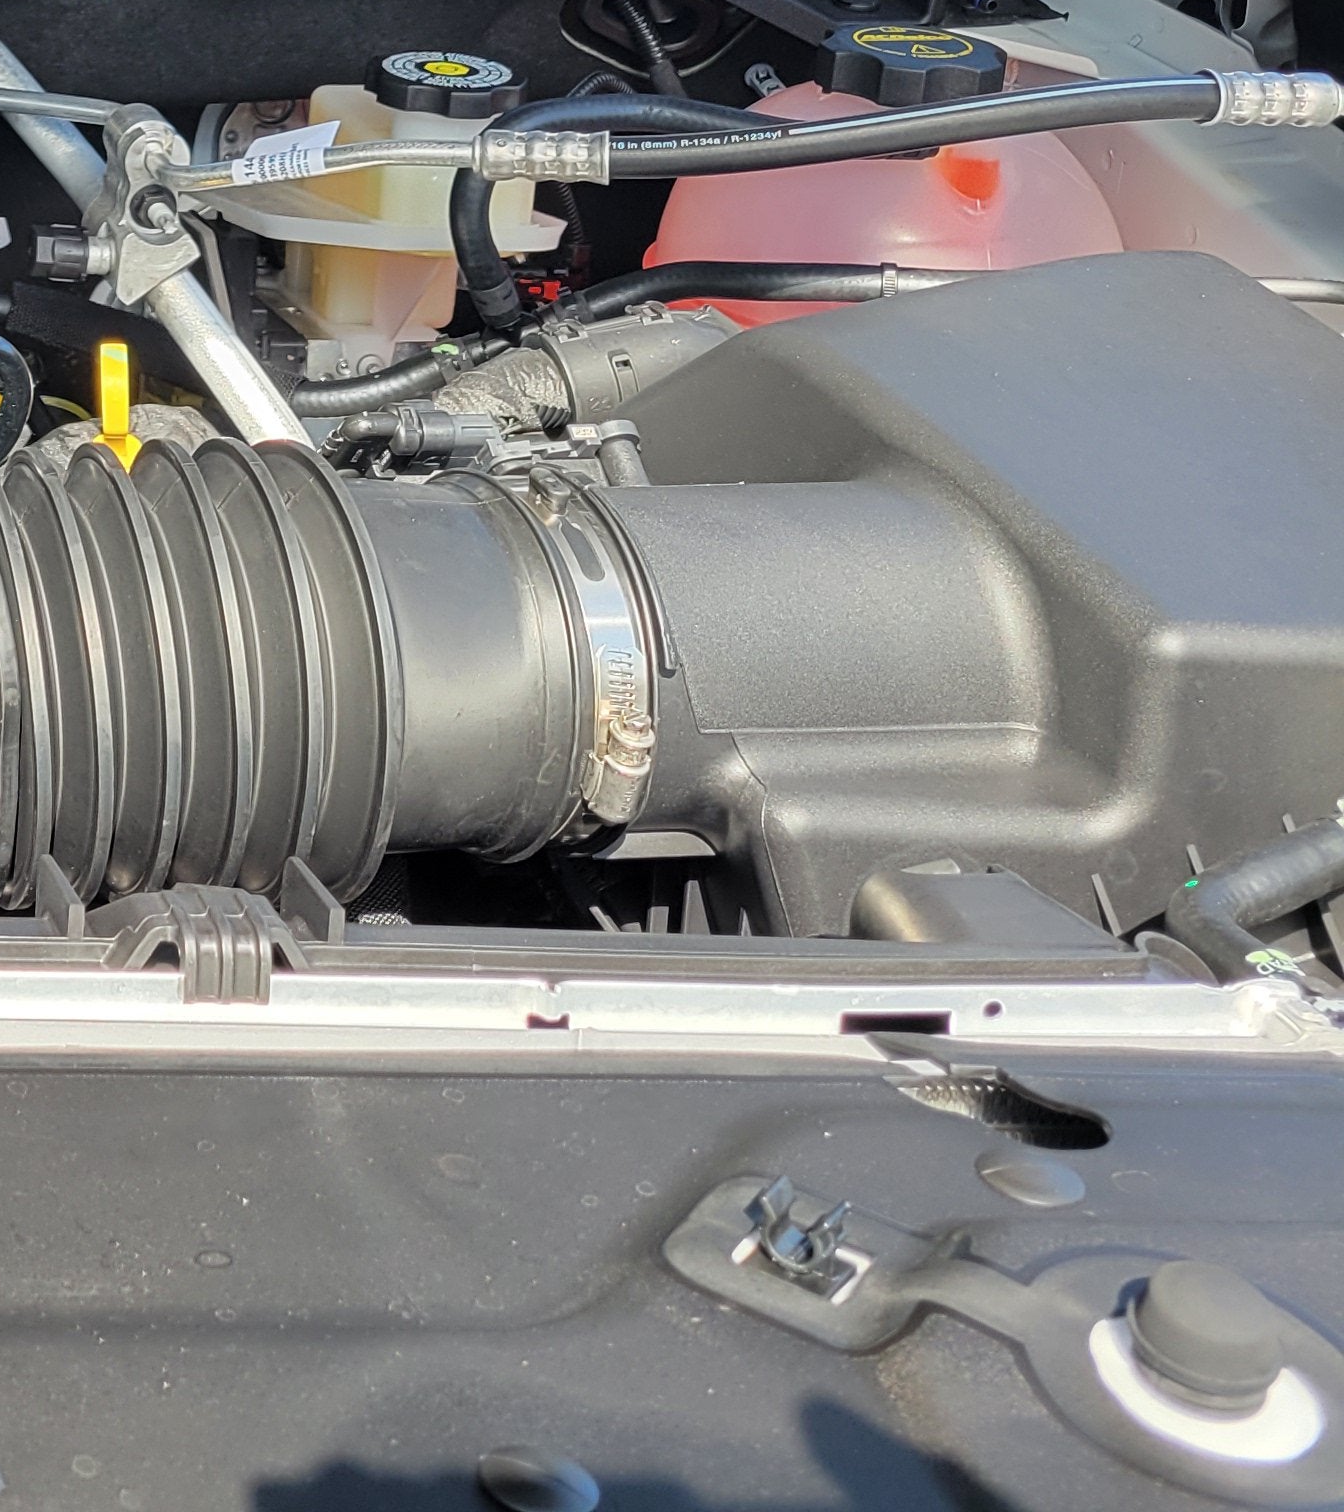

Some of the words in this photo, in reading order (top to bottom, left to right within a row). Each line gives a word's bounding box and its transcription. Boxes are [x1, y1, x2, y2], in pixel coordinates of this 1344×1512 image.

[627, 141, 638, 149] in
[641, 139, 678, 151] (8mm)
[680, 137, 721, 147] R-134a
[731, 130, 783, 144] R-1234yf
